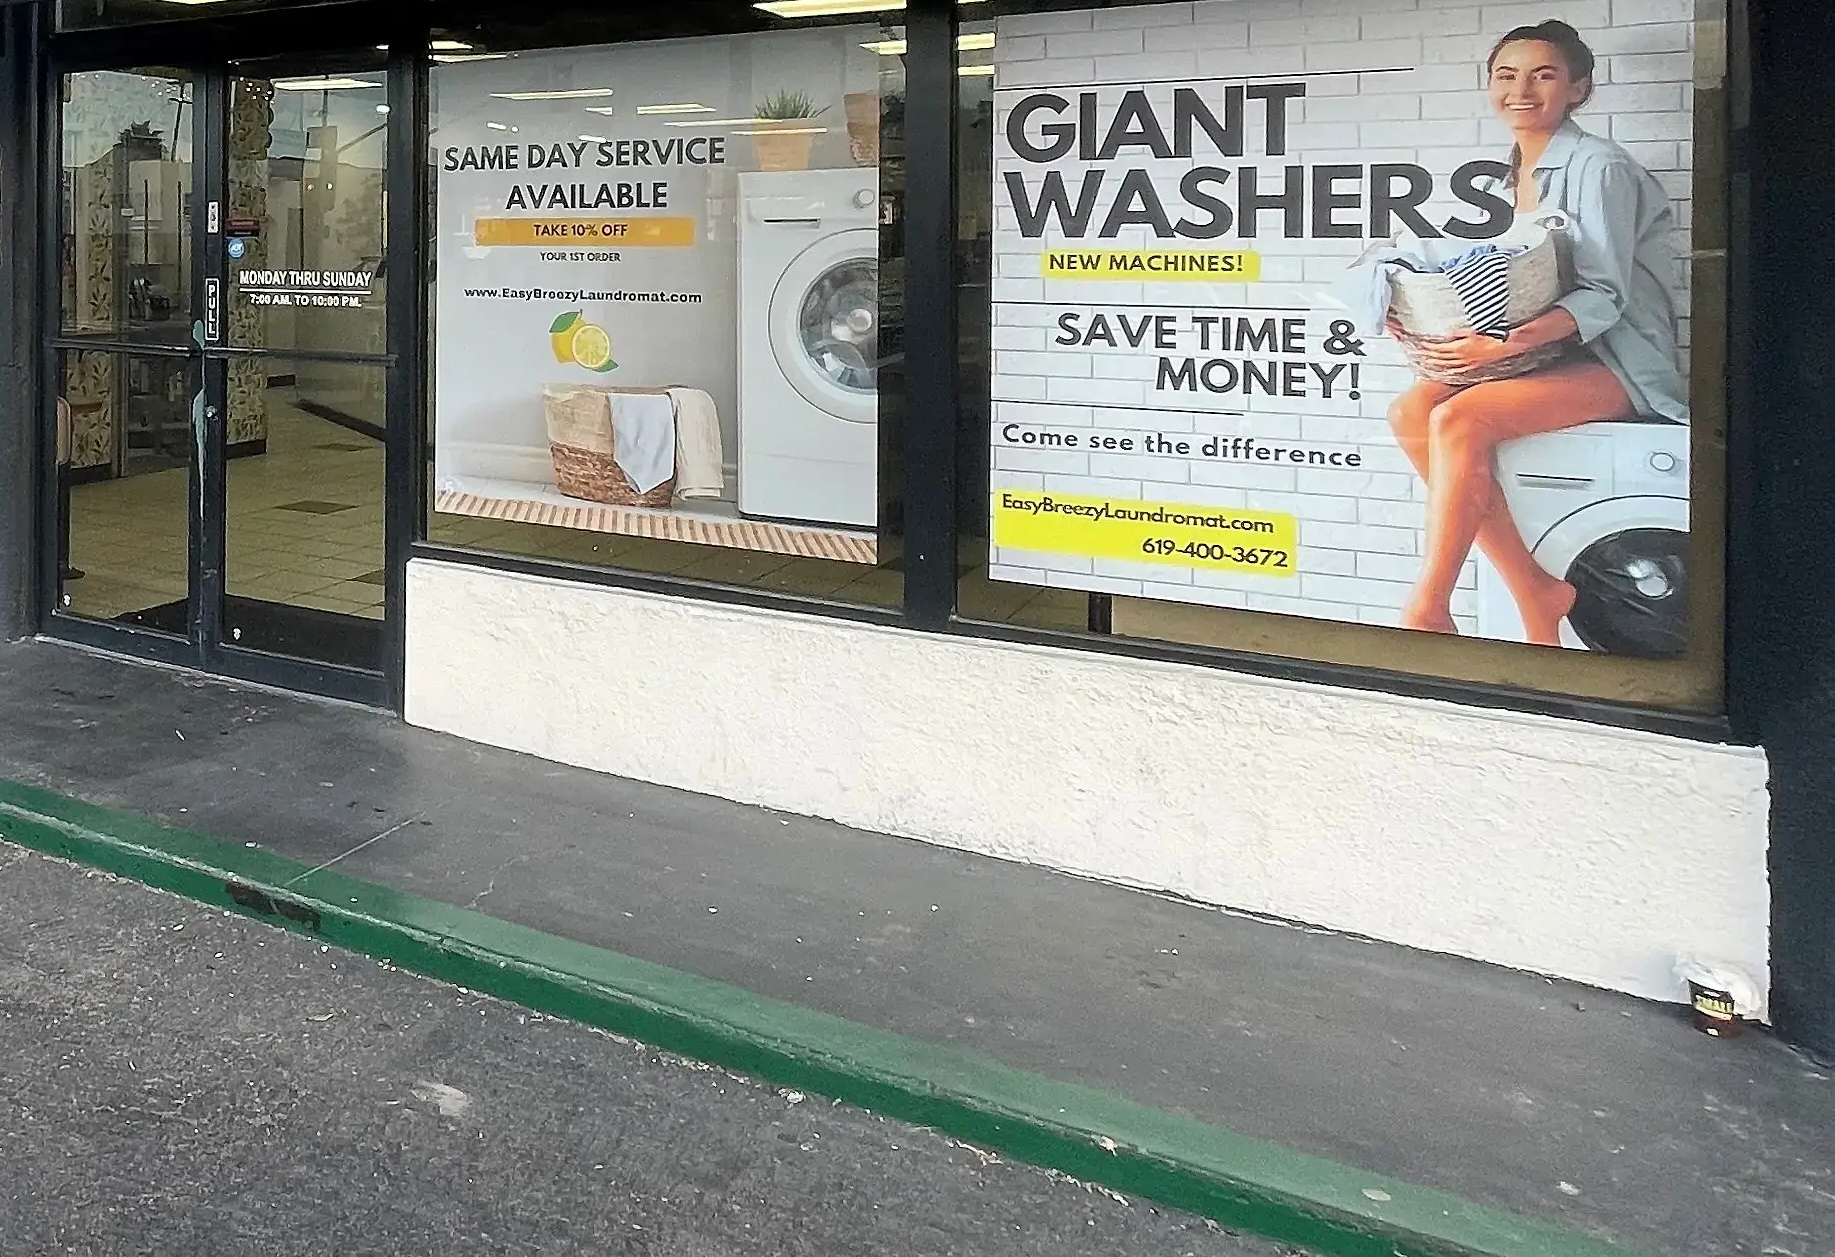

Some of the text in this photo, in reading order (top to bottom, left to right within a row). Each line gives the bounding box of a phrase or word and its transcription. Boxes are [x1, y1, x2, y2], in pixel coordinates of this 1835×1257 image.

[1006, 83, 1307, 162] GIANT
[444, 137, 726, 172] SAME DAY SERVICE
[506, 182, 667, 209] AVAILABLE
[1003, 160, 1515, 238] WASHERS
[533, 224, 628, 236] TAKE 10% OFF
[540, 252, 621, 262] YOUR 1ST ORDER
[1050, 254, 1244, 272] NEW MACHINES!
[239, 270, 372, 287] MONDAY THRU SUNDAY
[208, 284, 216, 334] PULL
[250, 294, 271, 305] 7:00
[295, 295, 309, 305] TO
[312, 295, 339, 307] 10:00
[1055, 313, 1367, 356] SAVE TIME &
[1156, 356, 1361, 400] MONEY!
[1002, 423, 1362, 467] Come see the difference
[1002, 494, 1275, 534] EasyBreezyLaundromat.com
[1142, 538, 1288, 568] 619-400-3672
